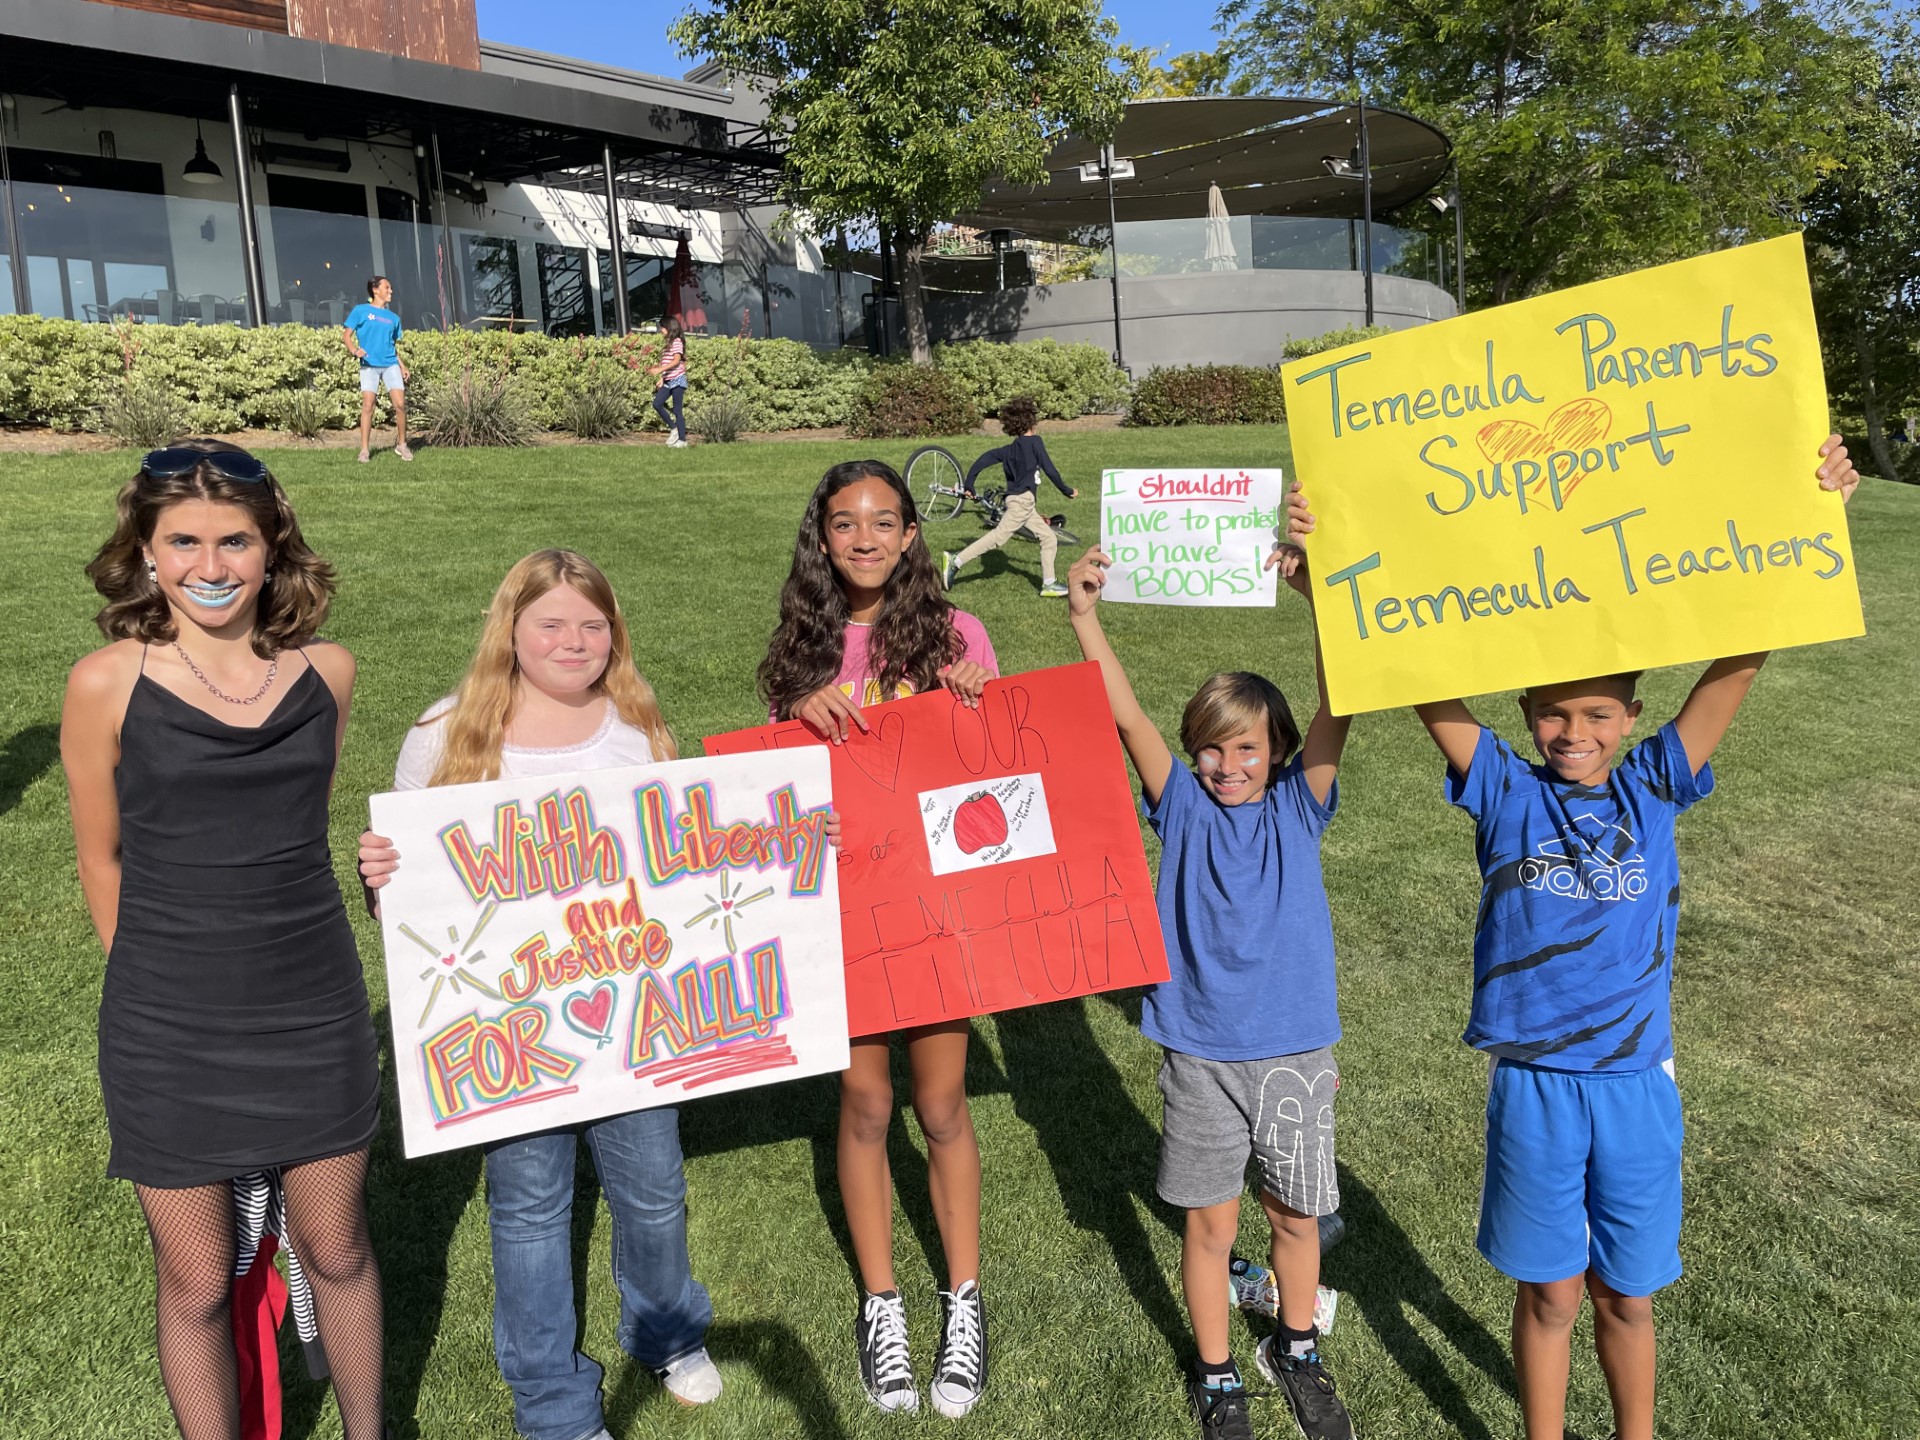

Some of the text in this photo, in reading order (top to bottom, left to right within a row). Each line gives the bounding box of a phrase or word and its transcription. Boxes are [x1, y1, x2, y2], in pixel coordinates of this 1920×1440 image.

[1296, 341, 1544, 437] Temecula
[1103, 471, 1127, 496] I
[1419, 402, 1690, 515] Support
[1107, 506, 1171, 537] have
[1179, 508, 1210, 531] to
[1107, 541, 1222, 564] to have
[1126, 545, 1264, 598] BOOKS!
[1326, 508, 1844, 639] Temecula Teachers
[952, 686, 1049, 774] OUR
[438, 779, 835, 905] With Liberty
[563, 878, 645, 937] and
[500, 918, 672, 1003] Justice
[418, 936, 794, 1123] FOR ALL!
